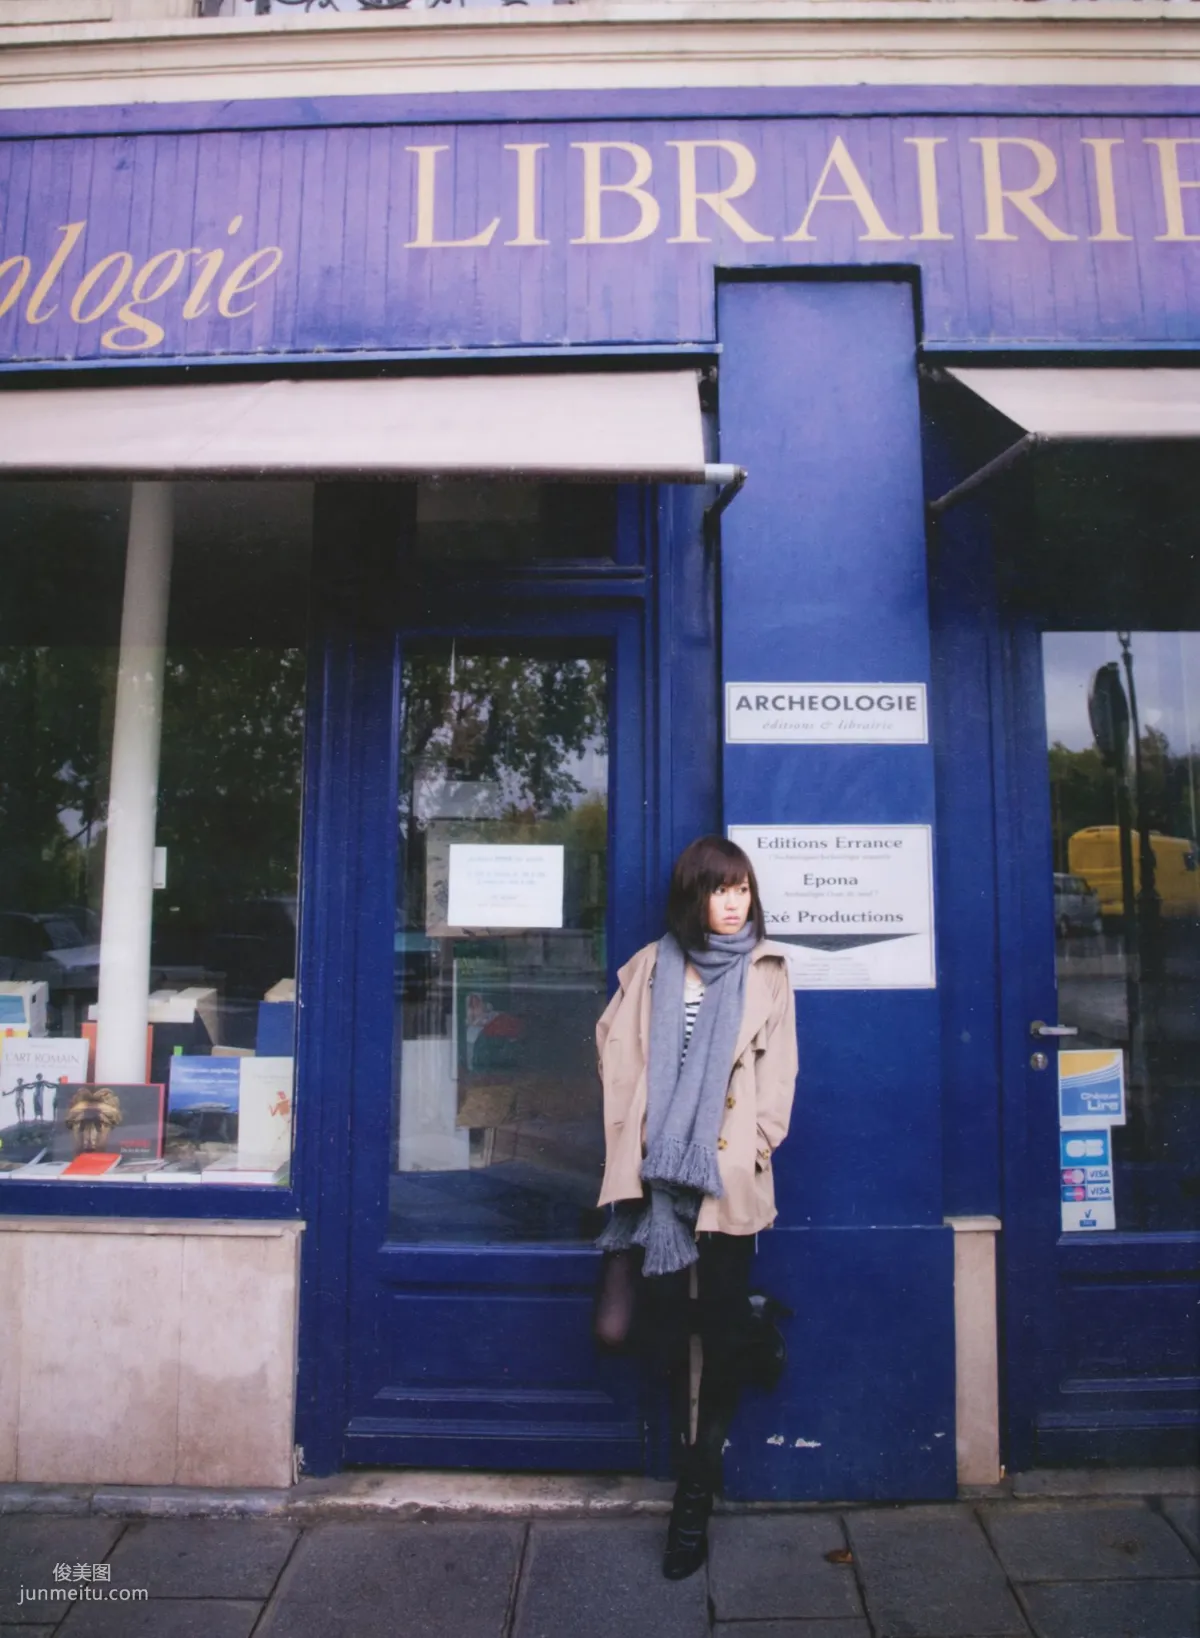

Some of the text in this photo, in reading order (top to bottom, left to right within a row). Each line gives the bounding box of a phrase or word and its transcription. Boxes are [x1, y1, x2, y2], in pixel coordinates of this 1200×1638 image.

[403, 135, 1200, 248] LIBRAIRIE
[735, 695, 918, 712] ARCHEOLOGIE
[762, 719, 814, 730] éditions
[837, 718, 894, 730] librairie
[757, 836, 903, 850] Editions Errance
[803, 873, 859, 889] Epona
[797, 910, 904, 924] Productions
[34, 1053, 80, 1065] ROMAIN
[1089, 1170, 1110, 1179] VISA
[1090, 1186, 1110, 1196] VISA
